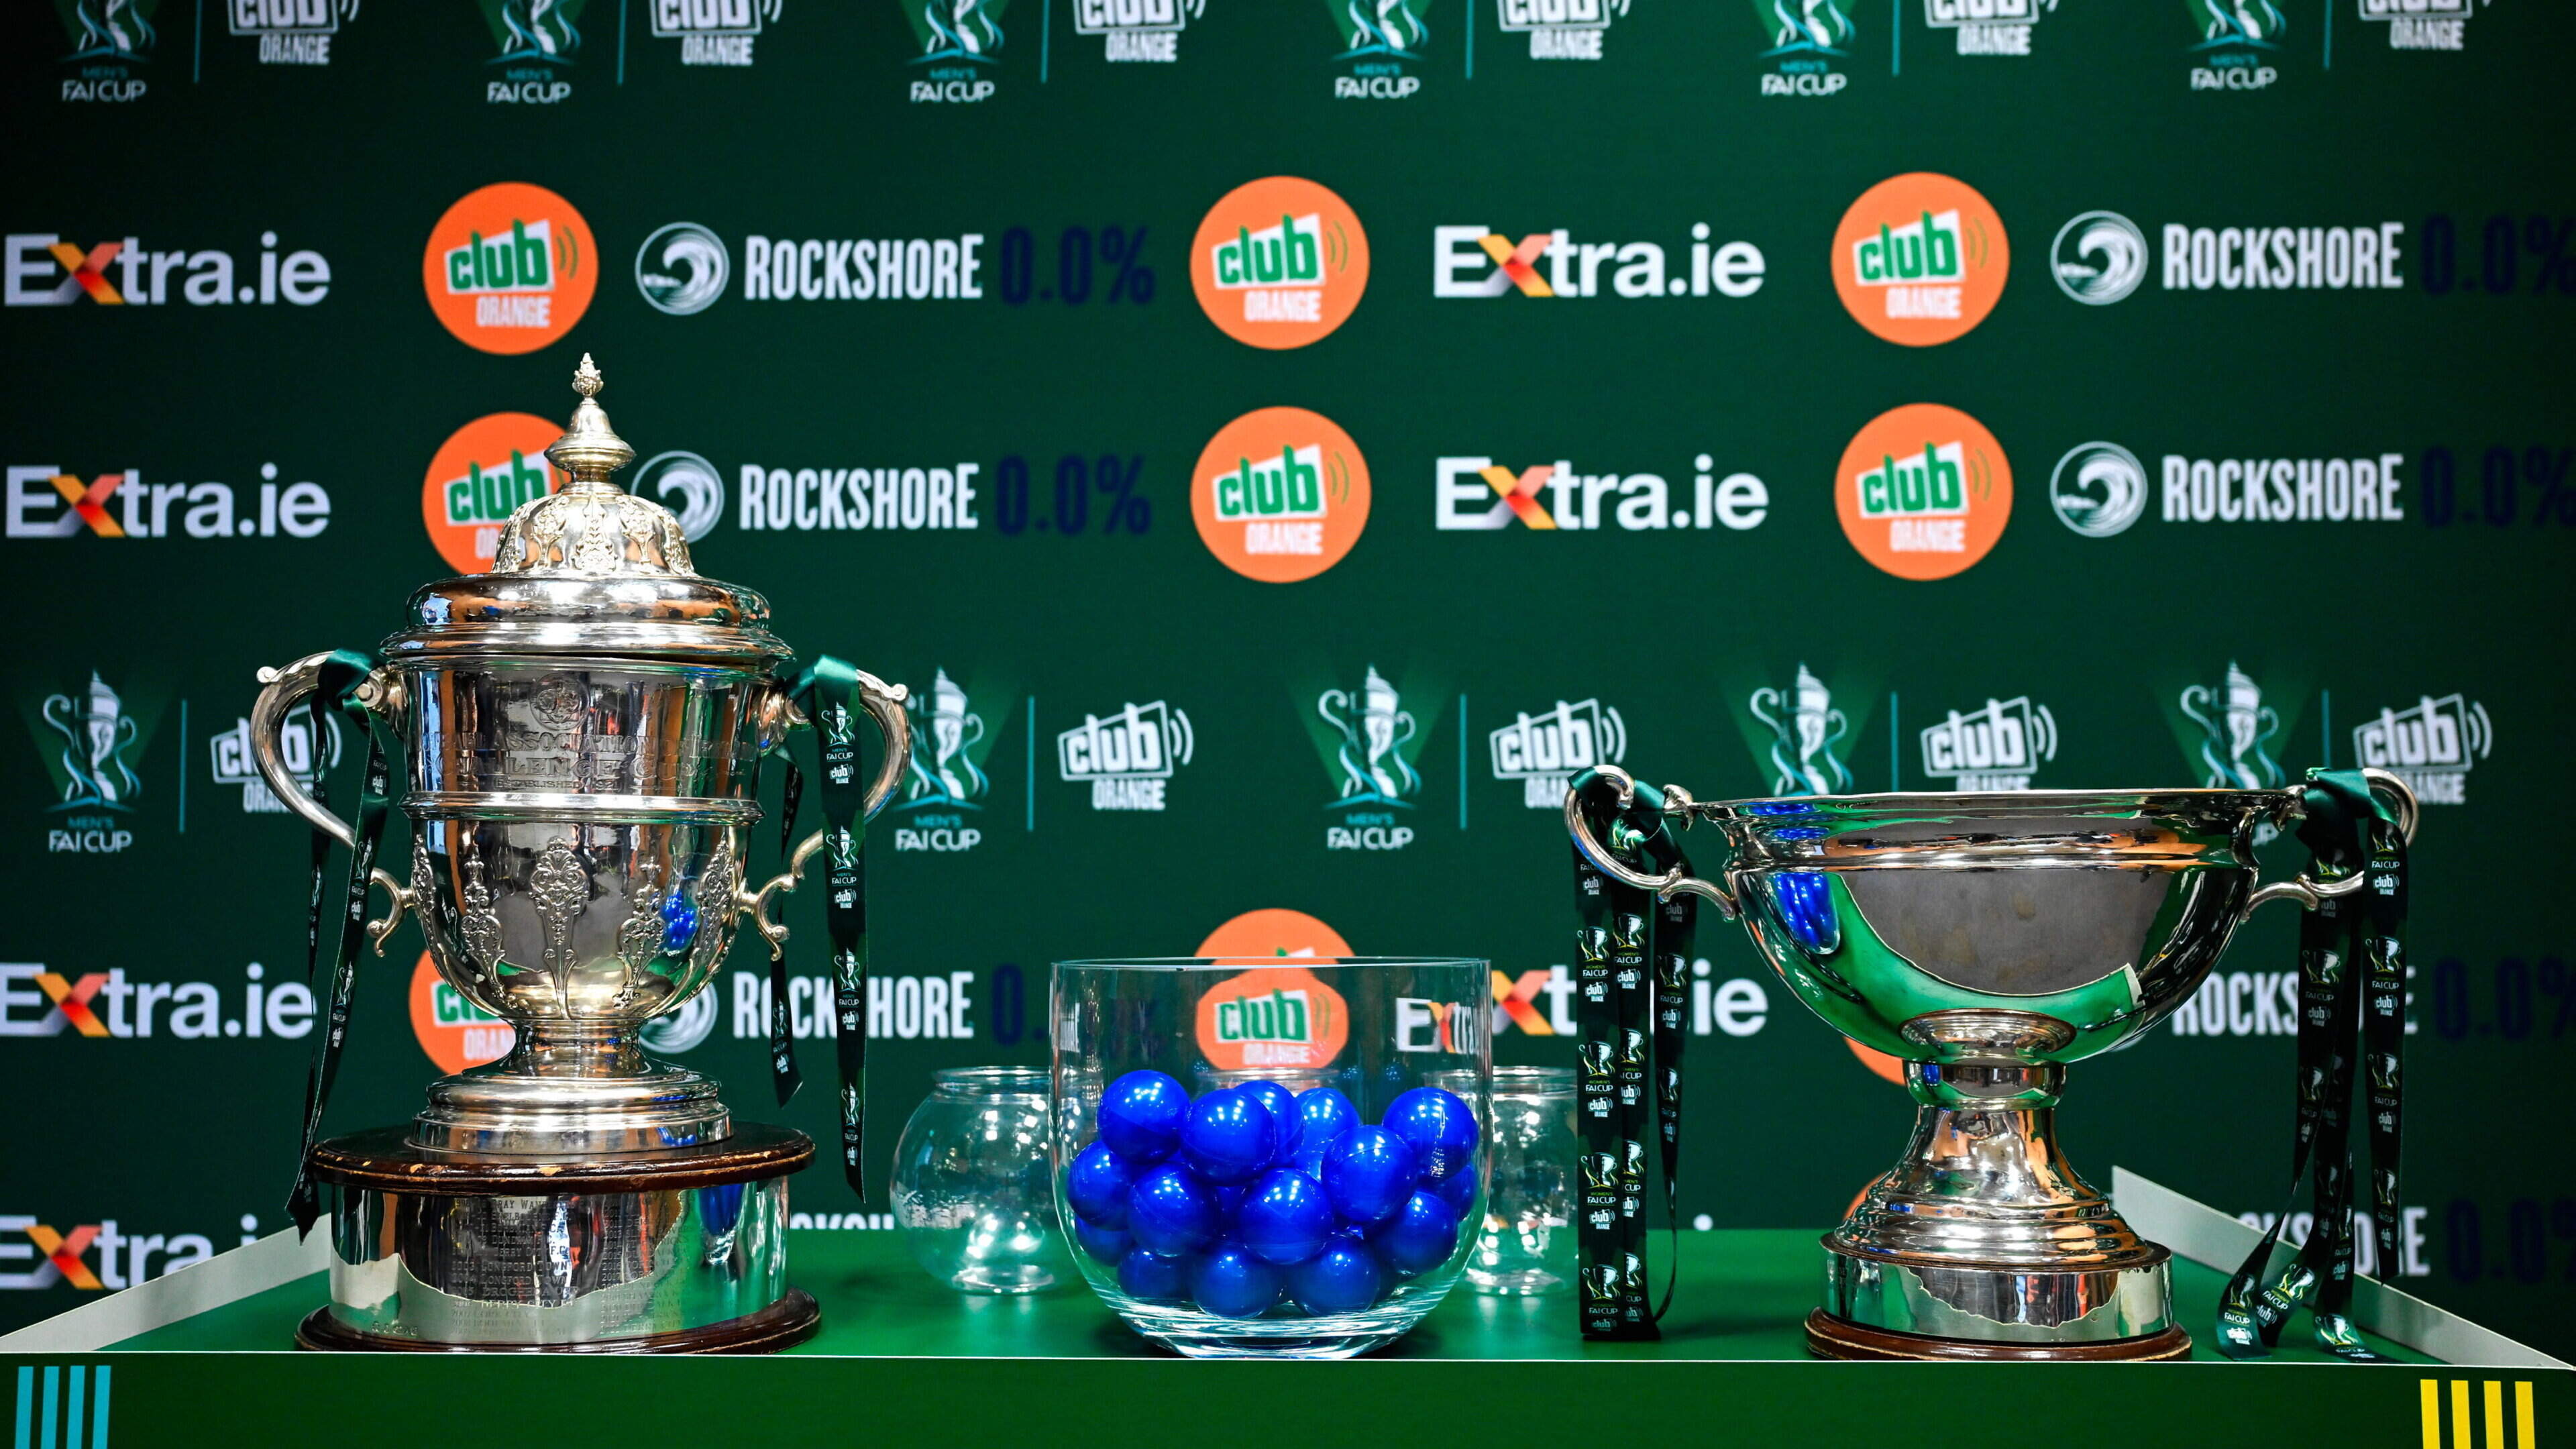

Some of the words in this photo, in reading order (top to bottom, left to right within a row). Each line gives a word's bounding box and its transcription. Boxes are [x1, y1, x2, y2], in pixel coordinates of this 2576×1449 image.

[259, 35, 330, 64] ORANGE
[1106, 32, 1177, 62] ORANGE
[1530, 30, 1603, 59] ORANGE
[1957, 25, 2031, 55] ORANGE
[2390, 20, 2463, 50] ORANGE
[682, 36, 753, 65] ORANGE
[2211, 55, 2258, 66] MEN'S
[82, 67, 129, 78] MEN'S
[506, 69, 553, 80] MEN'S
[929, 68, 977, 79] MEN'S
[1354, 64, 1402, 74] MEN'S
[1779, 60, 1827, 71] MEN'S
[2191, 68, 2224, 89] FAI
[2226, 68, 2277, 88] CUP
[62, 80, 93, 102] FAI
[98, 80, 146, 101] CUP
[488, 82, 519, 103] FAI
[524, 83, 571, 103] CUP
[910, 81, 943, 102] FAI
[945, 82, 994, 101] CUP
[1335, 77, 1367, 98] FAI
[1368, 78, 1419, 97] CUP
[1762, 74, 1795, 95] FAI
[1795, 75, 1847, 94] CUP
[448, 219, 550, 291] club
[1218, 215, 1319, 286] club
[1434, 223, 1764, 297] Extra.ie
[1855, 211, 1960, 282] club
[2163, 223, 2404, 289] ROCKSHORE
[5, 232, 330, 305] Extra.ie
[745, 234, 983, 299] ROCKSHORE
[1001, 227, 1155, 305] 0.0%
[477, 296, 551, 327] ORANGE
[1242, 288, 1321, 322] ORANGE
[1887, 287, 1961, 318] ORANGE
[449, 449, 547, 521] club
[1218, 445, 1320, 517] club
[1436, 455, 1768, 529] Extra.ie
[1862, 443, 1962, 512] club
[2163, 454, 2403, 521] ROCKSHORE
[7, 464, 329, 537] Extra.ie
[740, 464, 979, 529] ROCKSHORE
[995, 454, 1151, 535] 0.0%
[1246, 523, 1322, 554] ORANGE
[1891, 519, 1964, 551] ORANGE
[1067, 702, 1161, 773] club
[1499, 700, 1594, 772] club
[1929, 698, 2027, 769] club
[2365, 696, 2461, 766] club
[219, 717, 311, 775] clb
[830, 764, 848, 778] club
[1093, 780, 1165, 810] ORANGE
[1525, 777, 1570, 808] ORAN
[68, 816, 114, 828] MEN'S
[914, 816, 961, 827] MEN'S
[1346, 813, 1395, 824] MEN'S
[49, 830, 82, 852] FAI
[84, 830, 133, 853] CUP
[896, 829, 931, 850] FAI
[932, 830, 980, 850] CUP
[1328, 827, 1360, 849] FAI
[1362, 827, 1413, 849] CUP
[2383, 861, 2400, 869] CUP
[835, 889, 852, 903] club
[2373, 875, 2393, 888] club
[1585, 982, 1603, 996] club
[1617, 969, 1636, 983] club
[2383, 981, 2399, 989] CUP
[0, 962, 317, 1038] Extra.ie
[733, 971, 975, 1039] RCKHORE
[1221, 989, 1306, 1040] club
[2375, 995, 2393, 1008] club
[842, 1011, 856, 1024] club
[464, 1028, 517, 1061] ORAN
[1589, 1097, 1609, 1112] club
[1621, 1083, 1635, 1097] lub
[1590, 1210, 1609, 1224] club
